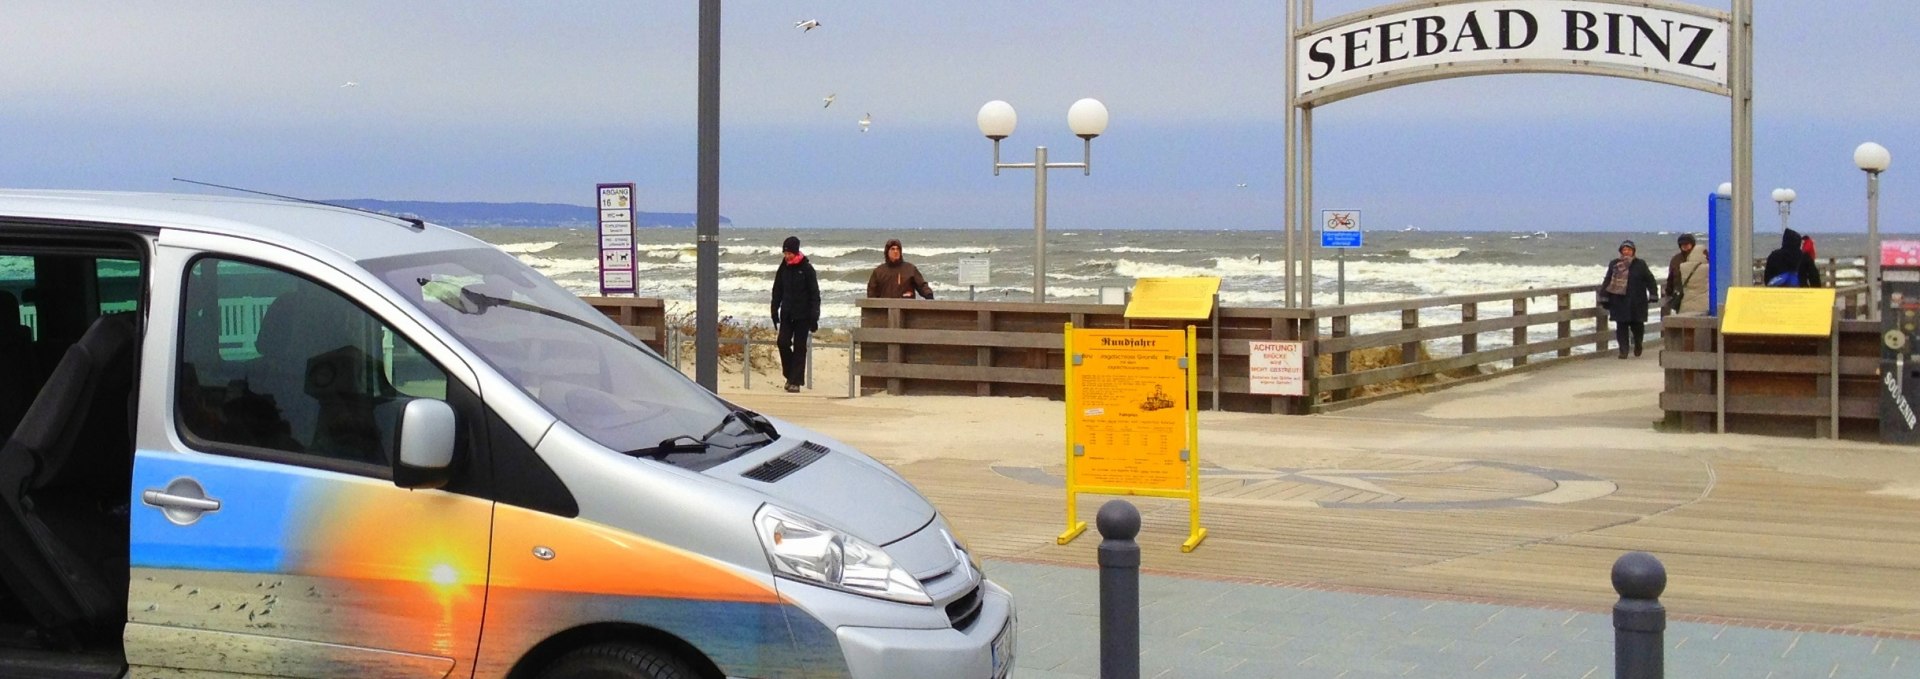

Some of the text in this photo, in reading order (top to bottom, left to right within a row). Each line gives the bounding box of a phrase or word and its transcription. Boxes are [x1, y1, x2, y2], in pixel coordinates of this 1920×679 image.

[1308, 9, 1717, 81] SEEBAD BINZ
[602, 188, 629, 196] ABGANG
[602, 199, 612, 207] 16
[1101, 337, 1156, 348] Rundfahrt
[1254, 344, 1297, 352] ACHTUNG!
[1884, 371, 1917, 431] SOUVENIR
